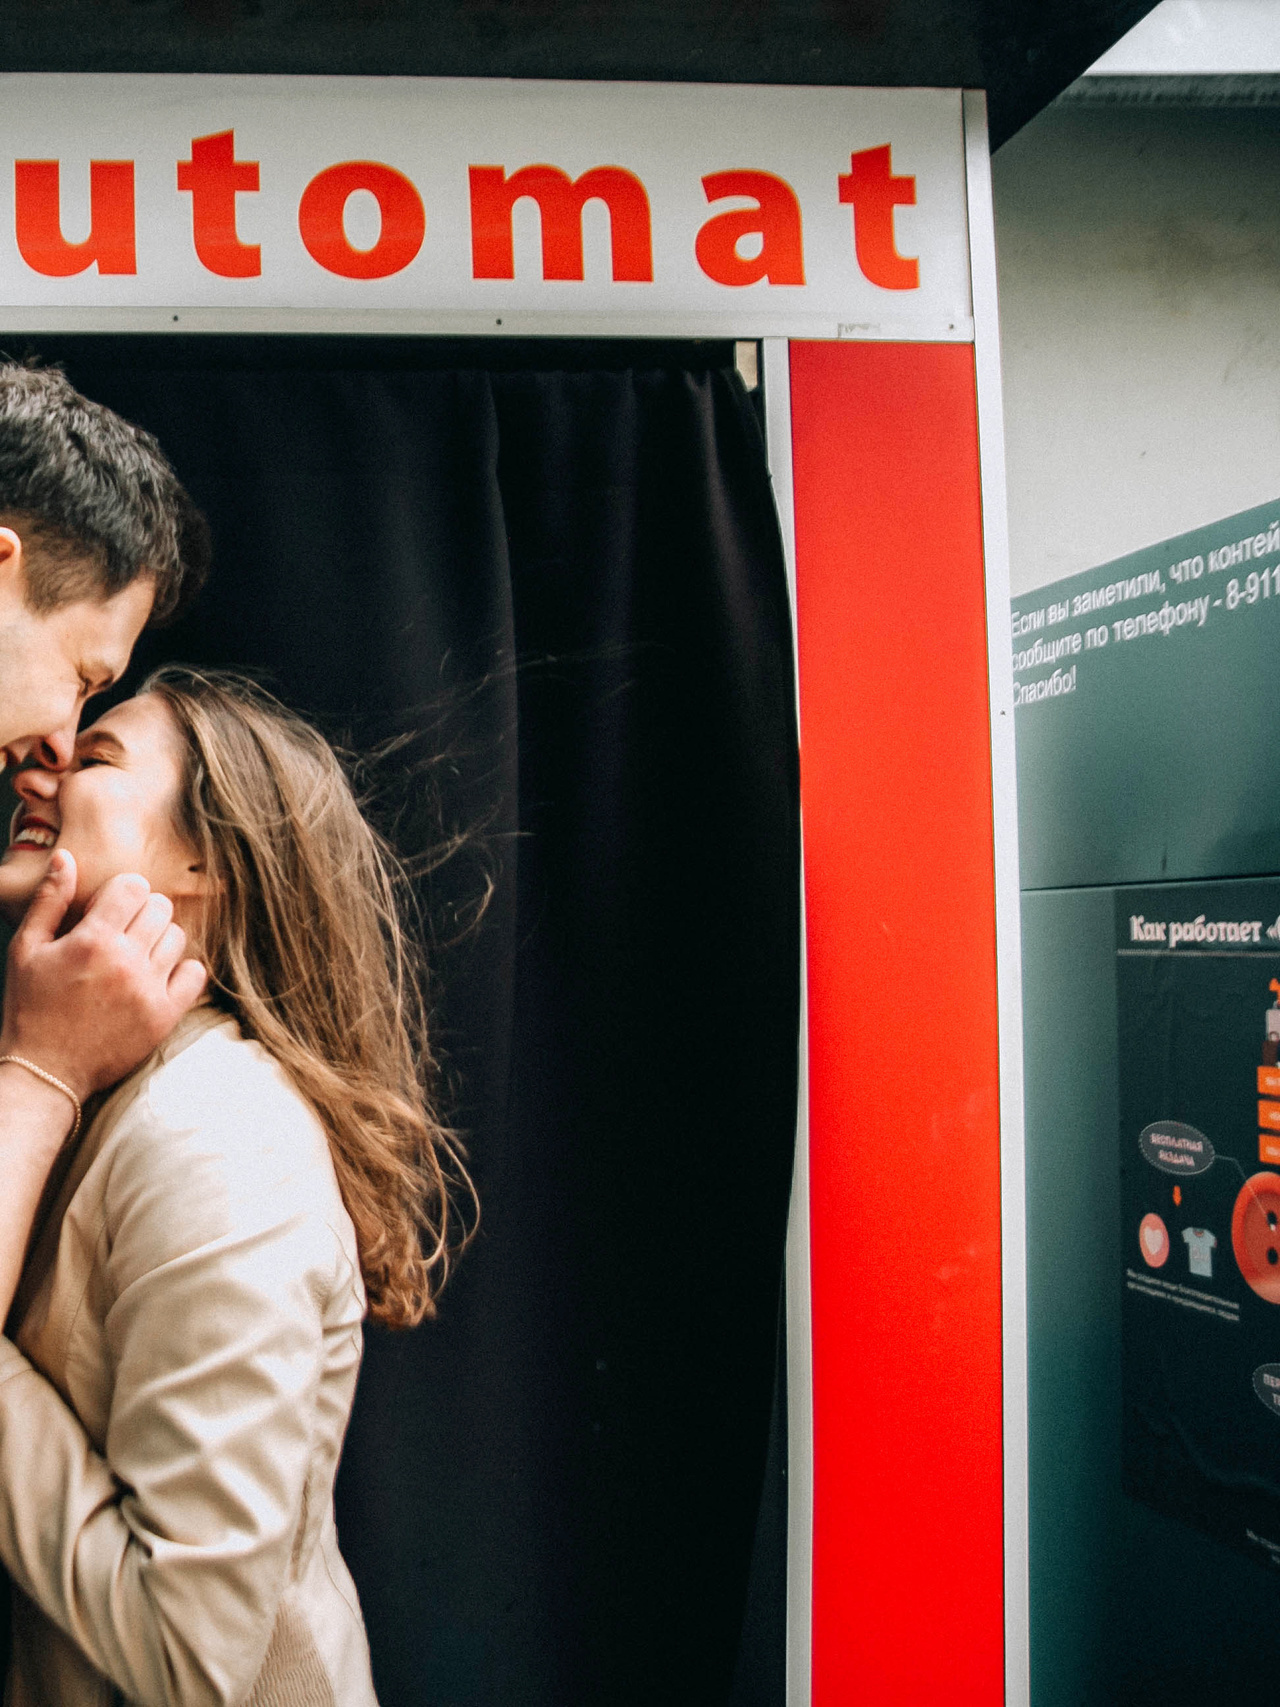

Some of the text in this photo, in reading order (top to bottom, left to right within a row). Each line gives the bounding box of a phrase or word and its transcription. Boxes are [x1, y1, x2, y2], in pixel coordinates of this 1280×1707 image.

[1011, 607, 1045, 637] Если
[1047, 599, 1070, 625] вы
[1072, 569, 1166, 617] заметили,
[1170, 555, 1204, 584] что
[1012, 632, 1082, 671] сообщите
[1084, 625, 1109, 651] по
[1113, 595, 1210, 642] телефону
[1130, 914, 1167, 942] Как
[1169, 914, 1263, 948] работает
